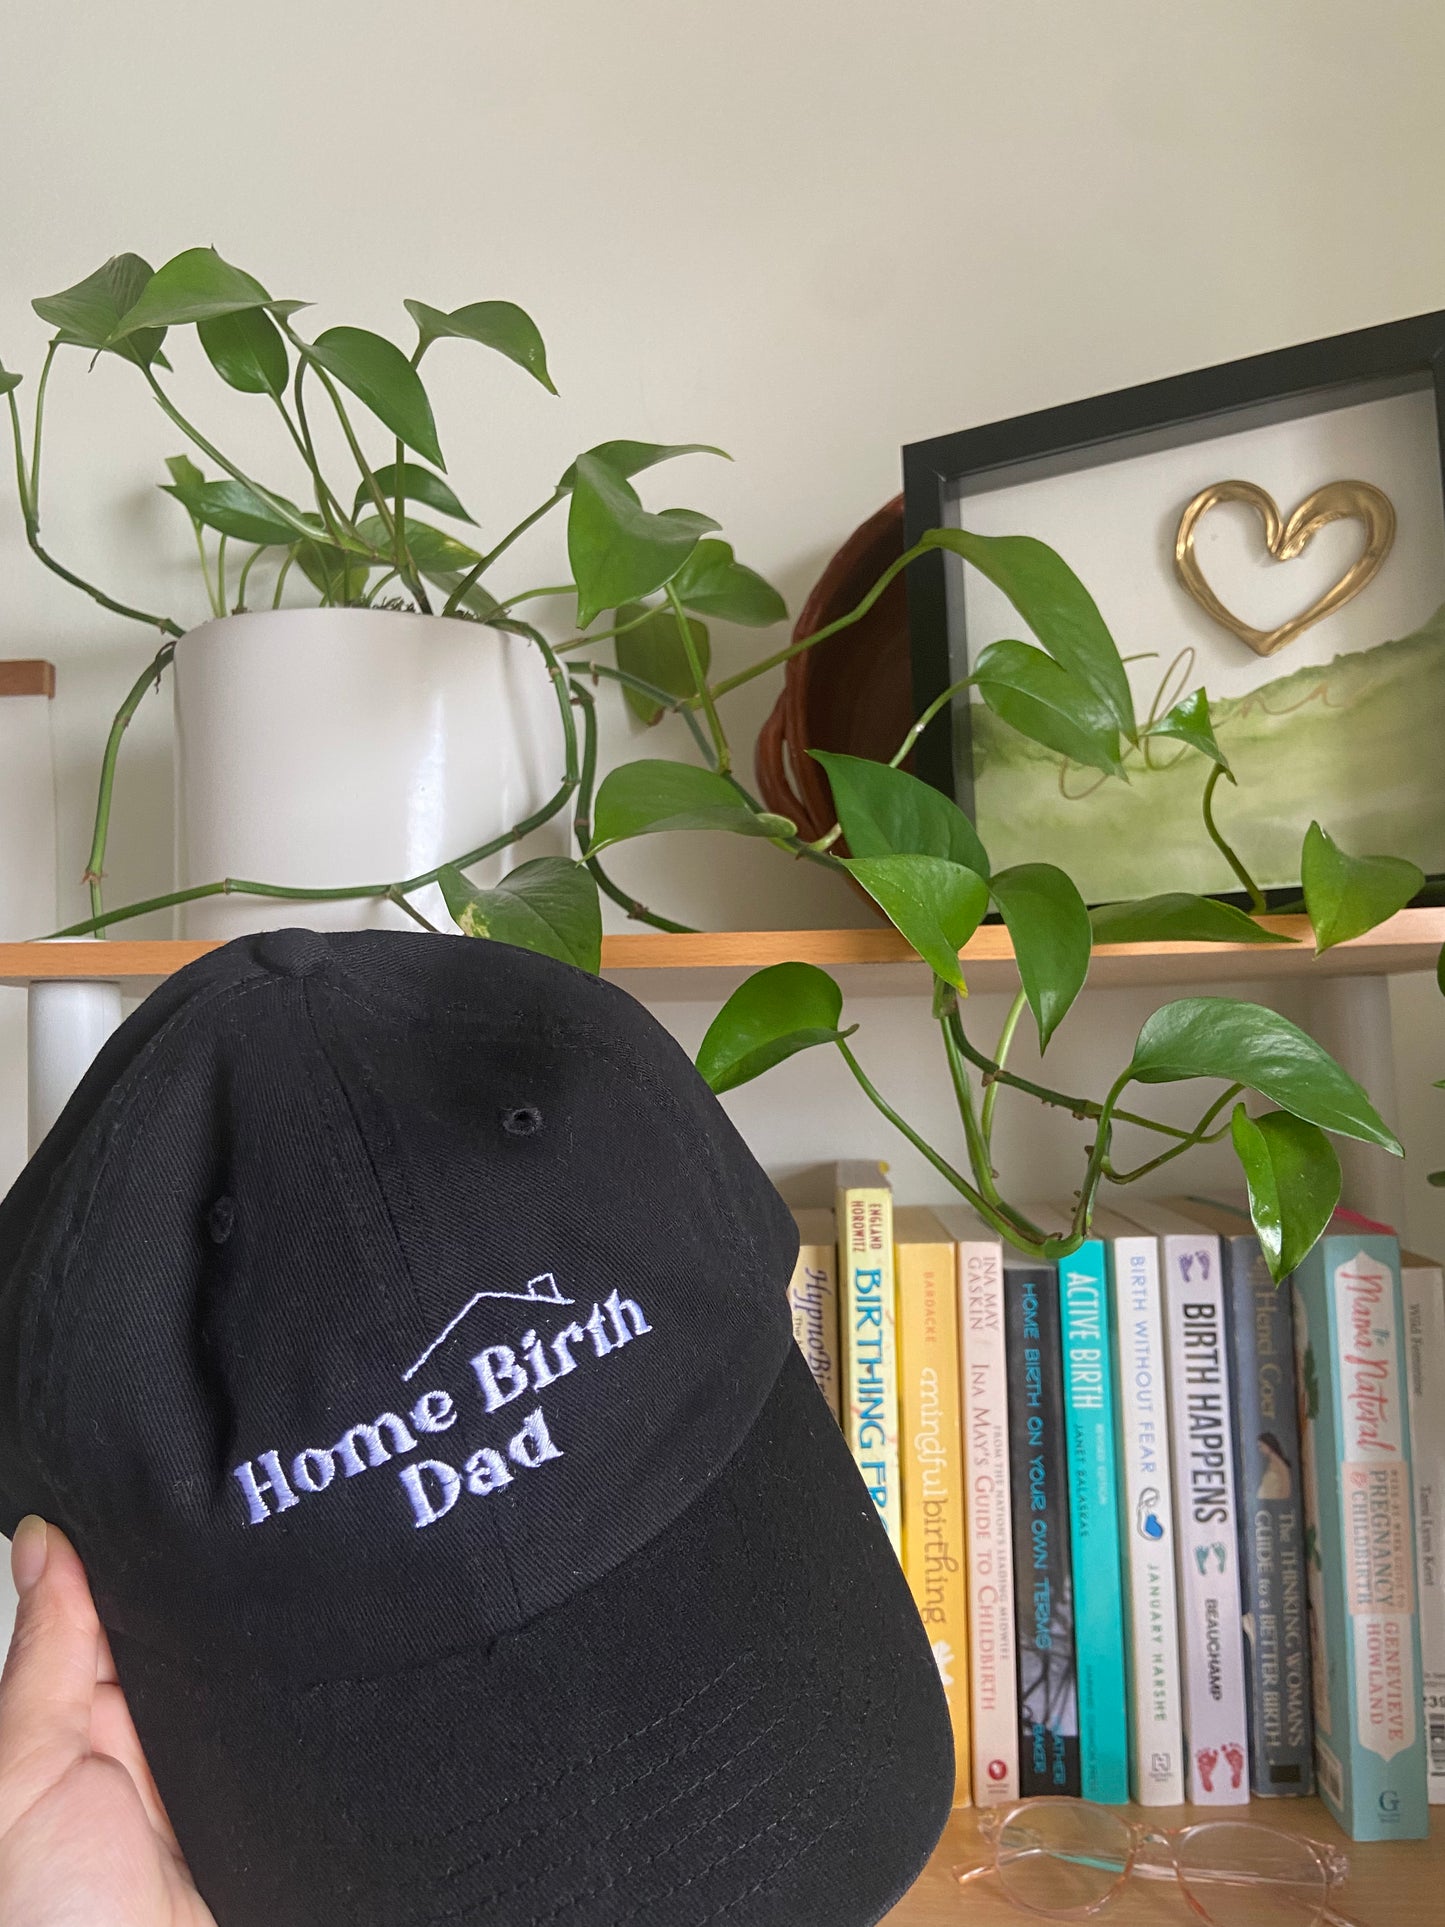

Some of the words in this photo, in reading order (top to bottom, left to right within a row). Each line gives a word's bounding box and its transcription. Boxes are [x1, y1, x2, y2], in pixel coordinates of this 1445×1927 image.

[850, 1200, 865, 1253] HOROWITZ
[867, 1202, 882, 1250] ENGLAND
[922, 1271, 937, 1343] BARDACKE
[967, 1256, 984, 1330] GASKIN
[983, 1256, 997, 1286] INA
[1066, 1271, 1099, 1340] ACTIVE
[1130, 1255, 1149, 1312] BIRTH
[984, 1293, 998, 1331] MAY
[1022, 1283, 1039, 1339] HOME
[1182, 1302, 1221, 1385] BIRTH
[1340, 1271, 1384, 1350] Mama
[855, 1267, 887, 1450] BIRTHING
[1024, 1349, 1042, 1407] BIRTH
[1069, 1349, 1104, 1410] BIRTH
[1135, 1321, 1153, 1412] WITHOUT
[233, 1390, 458, 1525] Home
[470, 1288, 653, 1413] Birth
[1027, 1416, 1044, 1446] ON
[1344, 1353, 1397, 1453] Natural
[400, 1405, 564, 1529] Dad
[1073, 1424, 1087, 1464] JANET
[1138, 1420, 1156, 1473] FEAR
[1187, 1394, 1227, 1524] HAPPENS
[1028, 1455, 1047, 1512] YOUR
[1031, 1519, 1048, 1570] OWN
[1254, 1509, 1274, 1574] GUIDE
[1278, 1509, 1297, 1543] The
[1351, 1490, 1373, 1606] CHILDBIRTH
[1368, 1470, 1394, 1607] PREGNANCY
[1034, 1577, 1052, 1650] TERMS
[1147, 1564, 1163, 1644] JANUARY
[1281, 1550, 1301, 1648] THINKING
[977, 1585, 999, 1711] CHILDBIRTH
[1204, 1598, 1223, 1701] BEAUCHAMP
[1259, 1613, 1279, 1686] BETTER
[1366, 1622, 1385, 1725] HOWLAND
[1384, 1621, 1405, 1741] GENEVIEVE
[1152, 1654, 1167, 1721] HARSHE
[1262, 1690, 1281, 1748] BIRTH
